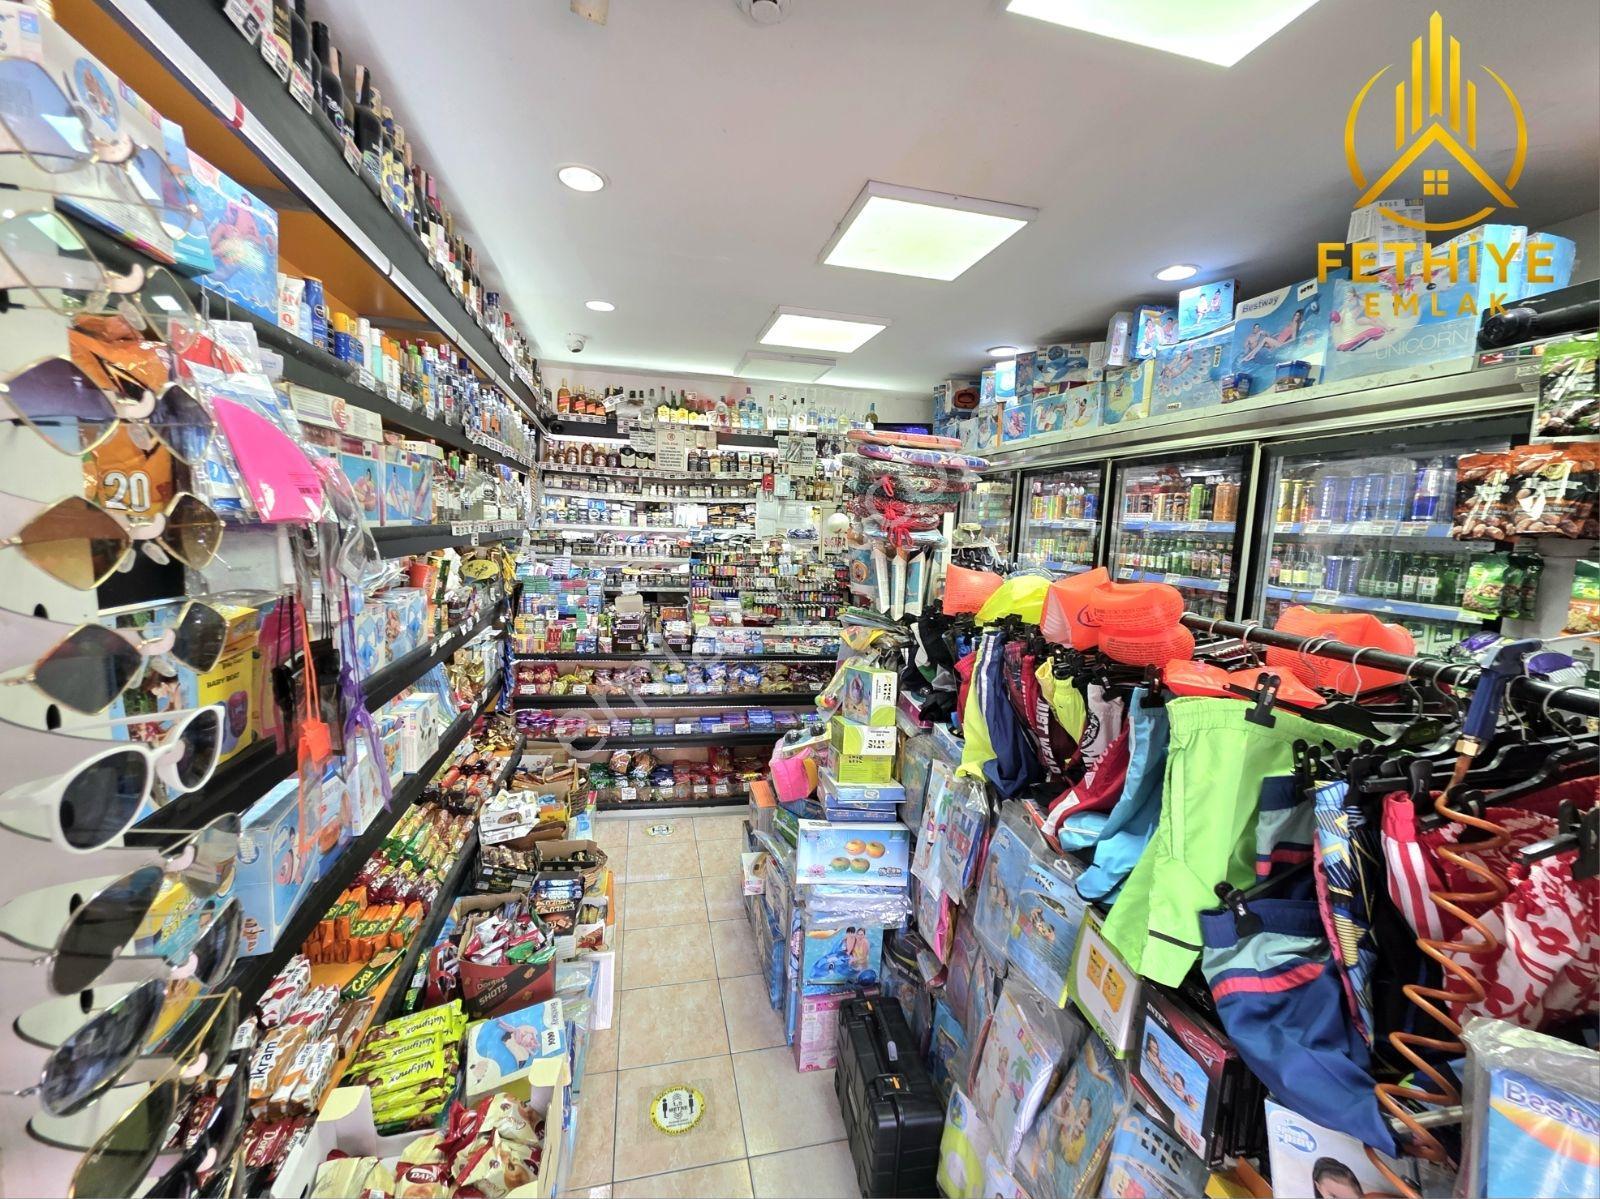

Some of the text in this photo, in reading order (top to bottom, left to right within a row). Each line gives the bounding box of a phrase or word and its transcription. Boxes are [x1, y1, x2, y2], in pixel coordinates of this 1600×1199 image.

[1375, 326, 1471, 361] UNICORN
[102, 470, 151, 512] 20
[479, 981, 508, 1006] SHOTS
[1146, 1002, 1170, 1029] INTEX
